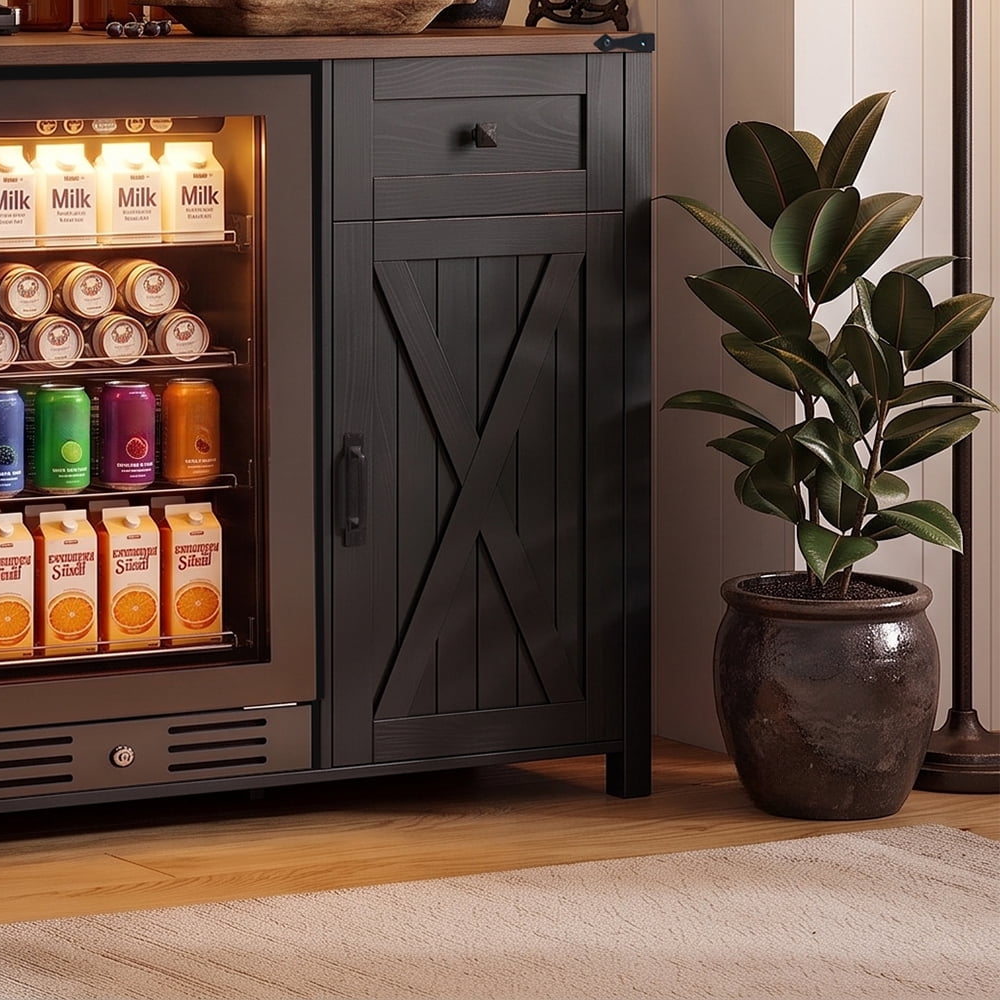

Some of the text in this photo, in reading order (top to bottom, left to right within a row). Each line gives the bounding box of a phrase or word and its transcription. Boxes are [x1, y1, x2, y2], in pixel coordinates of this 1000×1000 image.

[52, 187, 92, 209] Milk
[118, 186, 157, 208] Milk
[181, 185, 220, 207] Milk
